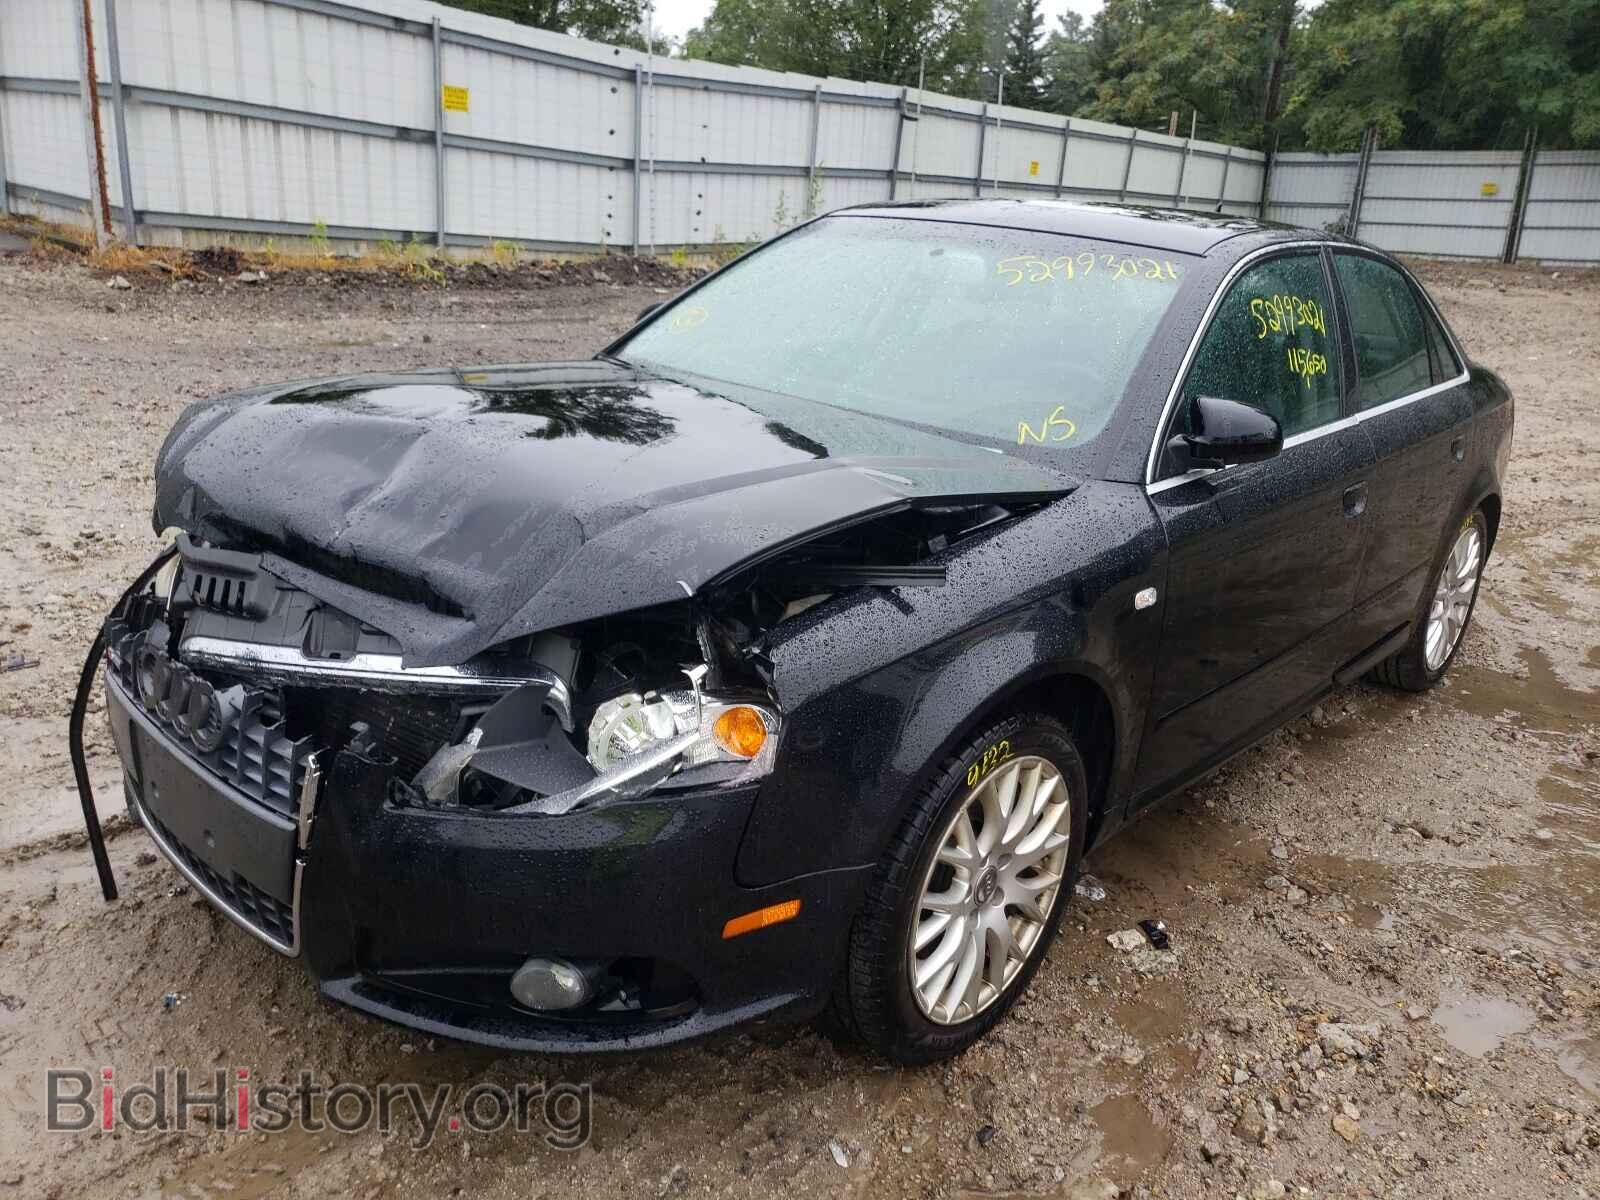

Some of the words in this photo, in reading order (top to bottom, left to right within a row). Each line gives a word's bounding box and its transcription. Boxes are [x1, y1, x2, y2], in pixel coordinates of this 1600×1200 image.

[996, 252, 1177, 286] 52993021
[1251, 294, 1326, 339] 52993021
[1018, 405, 1076, 445] NS
